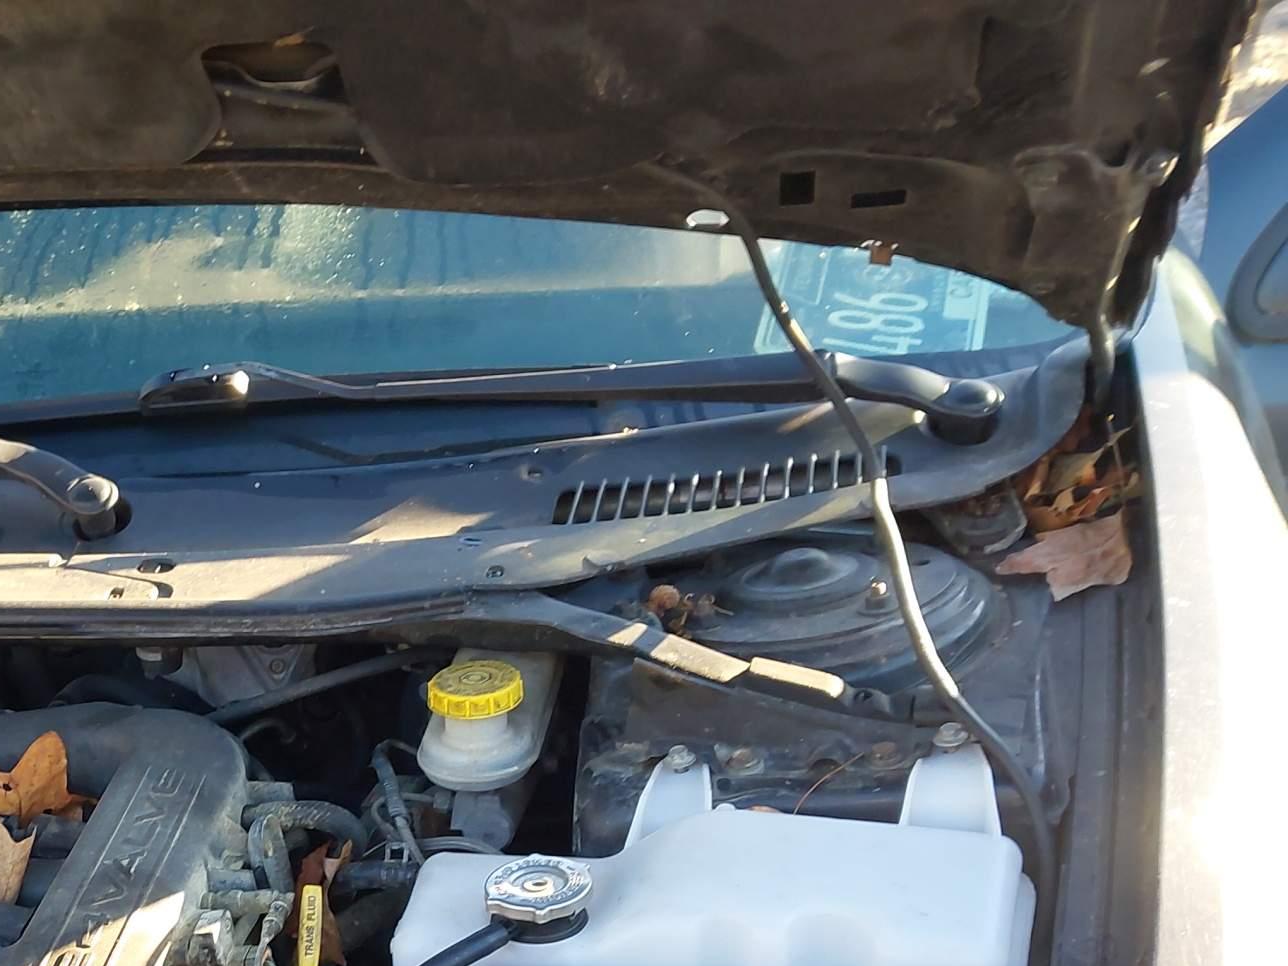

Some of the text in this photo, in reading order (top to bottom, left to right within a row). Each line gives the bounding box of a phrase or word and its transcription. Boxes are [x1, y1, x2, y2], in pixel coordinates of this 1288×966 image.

[89, 767, 186, 906] VALVE
[304, 896, 317, 957] TRANS FLUID
